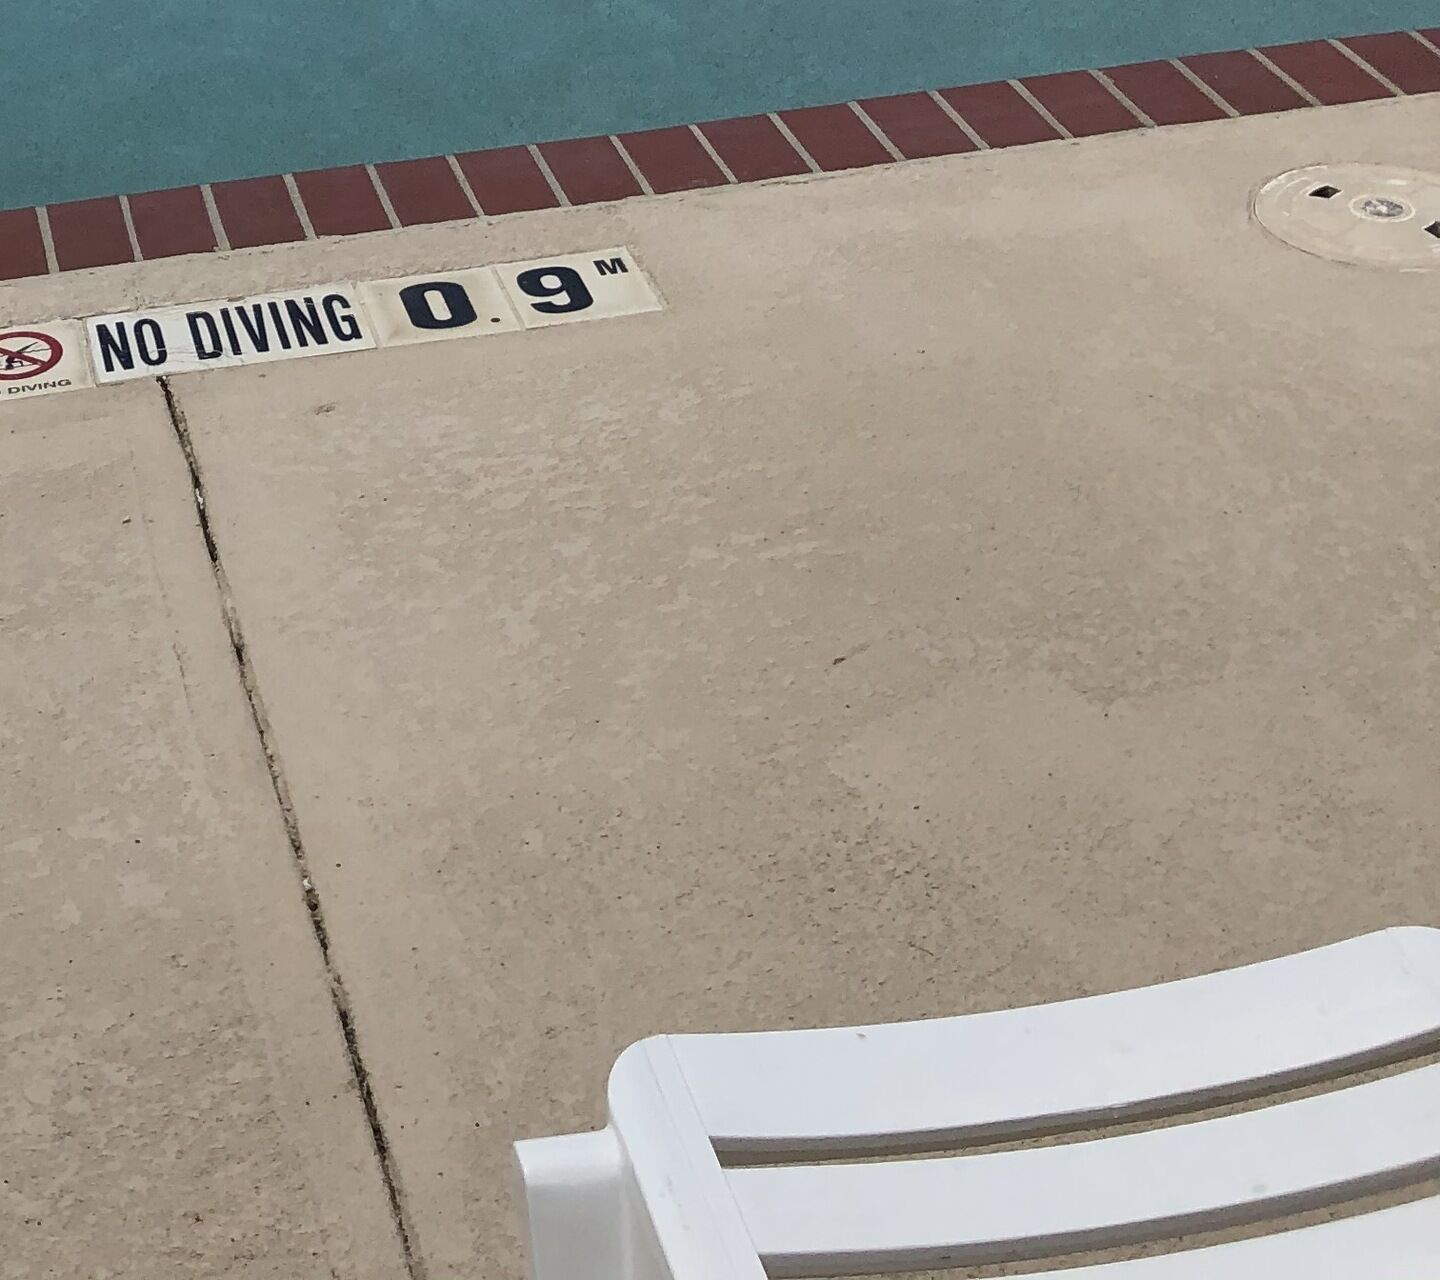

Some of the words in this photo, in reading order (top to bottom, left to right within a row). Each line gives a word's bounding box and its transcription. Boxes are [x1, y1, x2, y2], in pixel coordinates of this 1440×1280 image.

[95, 318, 167, 373] NO
[187, 293, 362, 361] DIVING
[7, 378, 72, 395] DIVING
